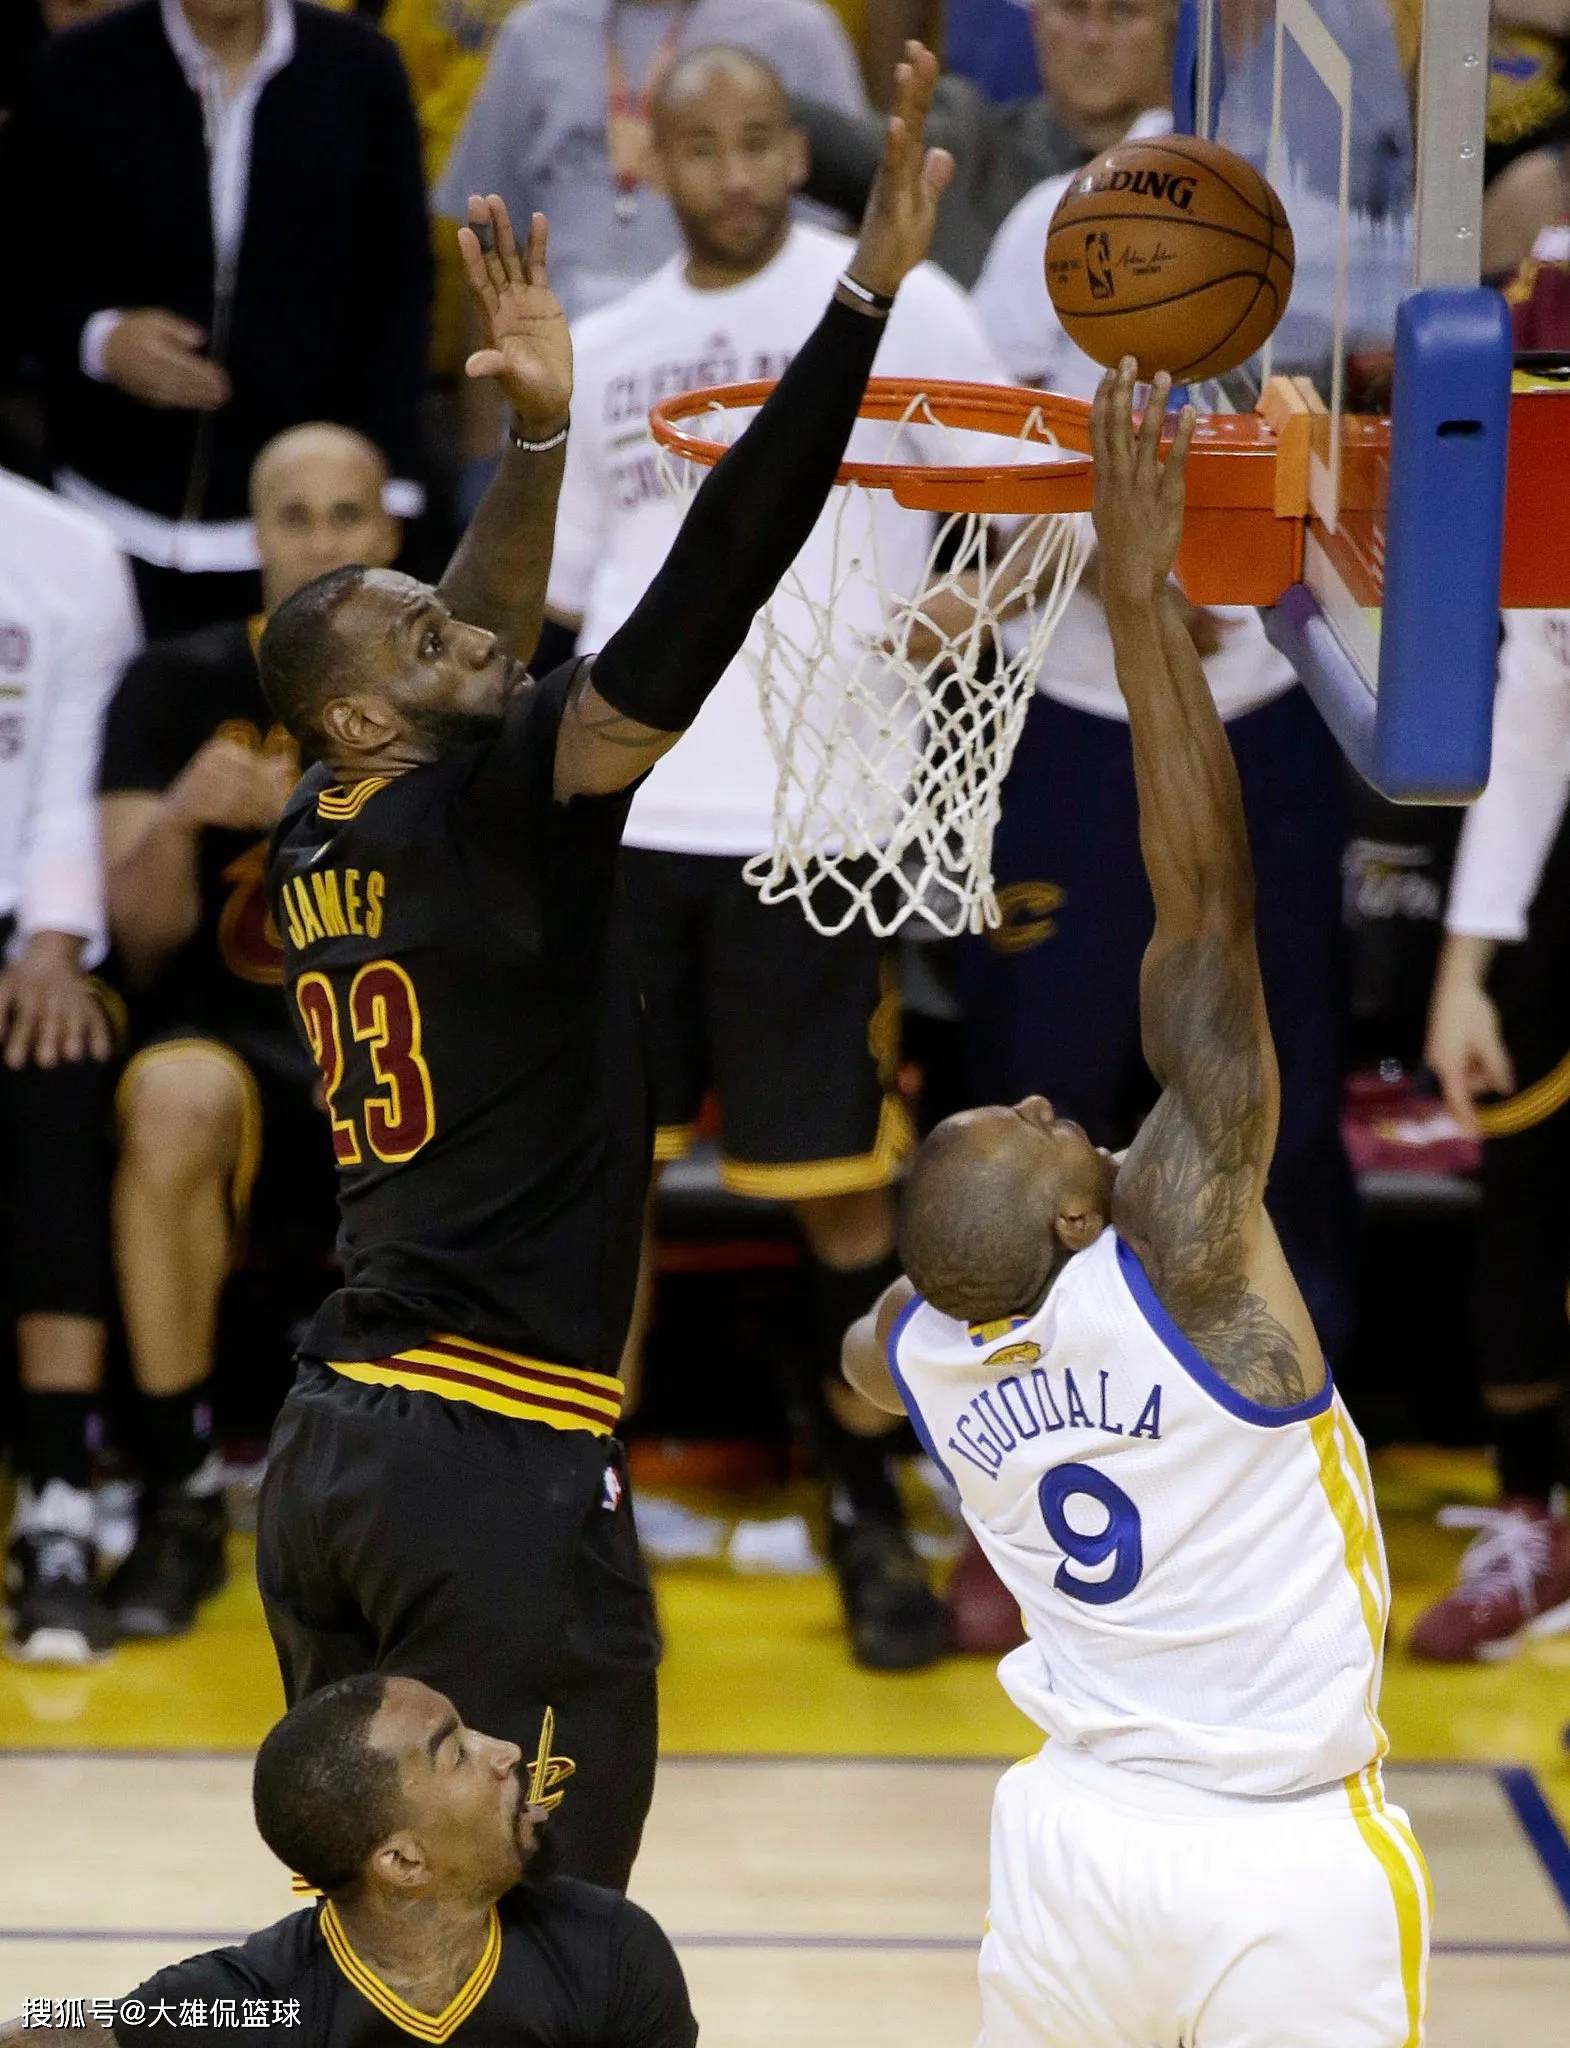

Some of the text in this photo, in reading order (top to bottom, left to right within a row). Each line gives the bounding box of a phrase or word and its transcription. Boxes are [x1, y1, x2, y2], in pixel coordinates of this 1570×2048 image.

[1076, 169, 1198, 210] LDING
[283, 868, 385, 950] JAMES
[296, 959, 436, 1166] 23
[949, 1367, 1162, 1481] IGUODALA
[1038, 1462, 1144, 1606] 9
